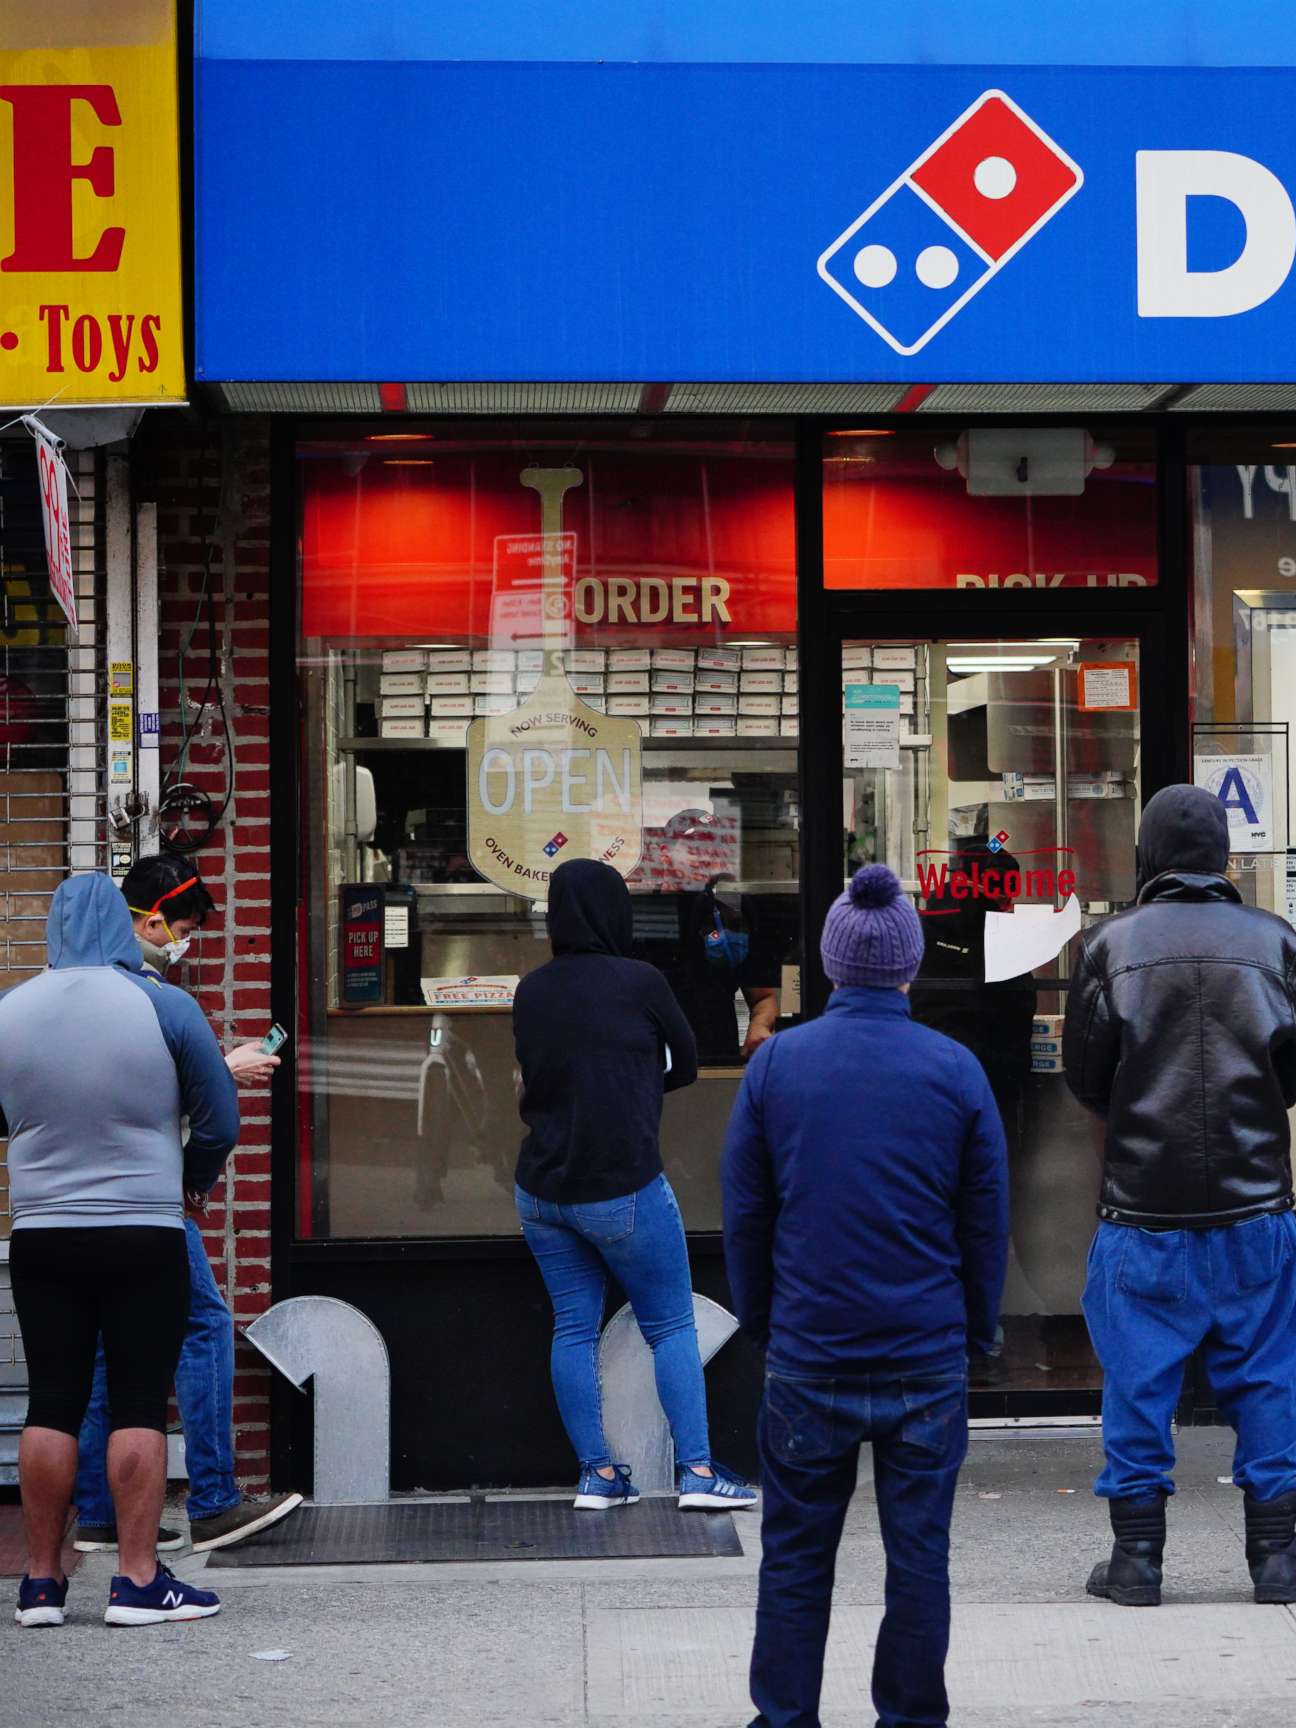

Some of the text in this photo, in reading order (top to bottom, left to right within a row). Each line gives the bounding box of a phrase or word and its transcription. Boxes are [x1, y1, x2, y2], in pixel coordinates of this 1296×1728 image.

[39, 304, 161, 382] Toys
[575, 577, 732, 624] ORDER
[511, 713, 598, 738] NOW SERVING
[479, 748, 633, 817] OPEN
[1217, 767, 1260, 824] A
[485, 837, 513, 869] OVEN
[513, 863, 555, 882] BAKE
[917, 862, 1077, 900] Welcome
[348, 930, 379, 944] PICK UP
[353, 944, 374, 958] HERE
[434, 991, 467, 1000] FREE
